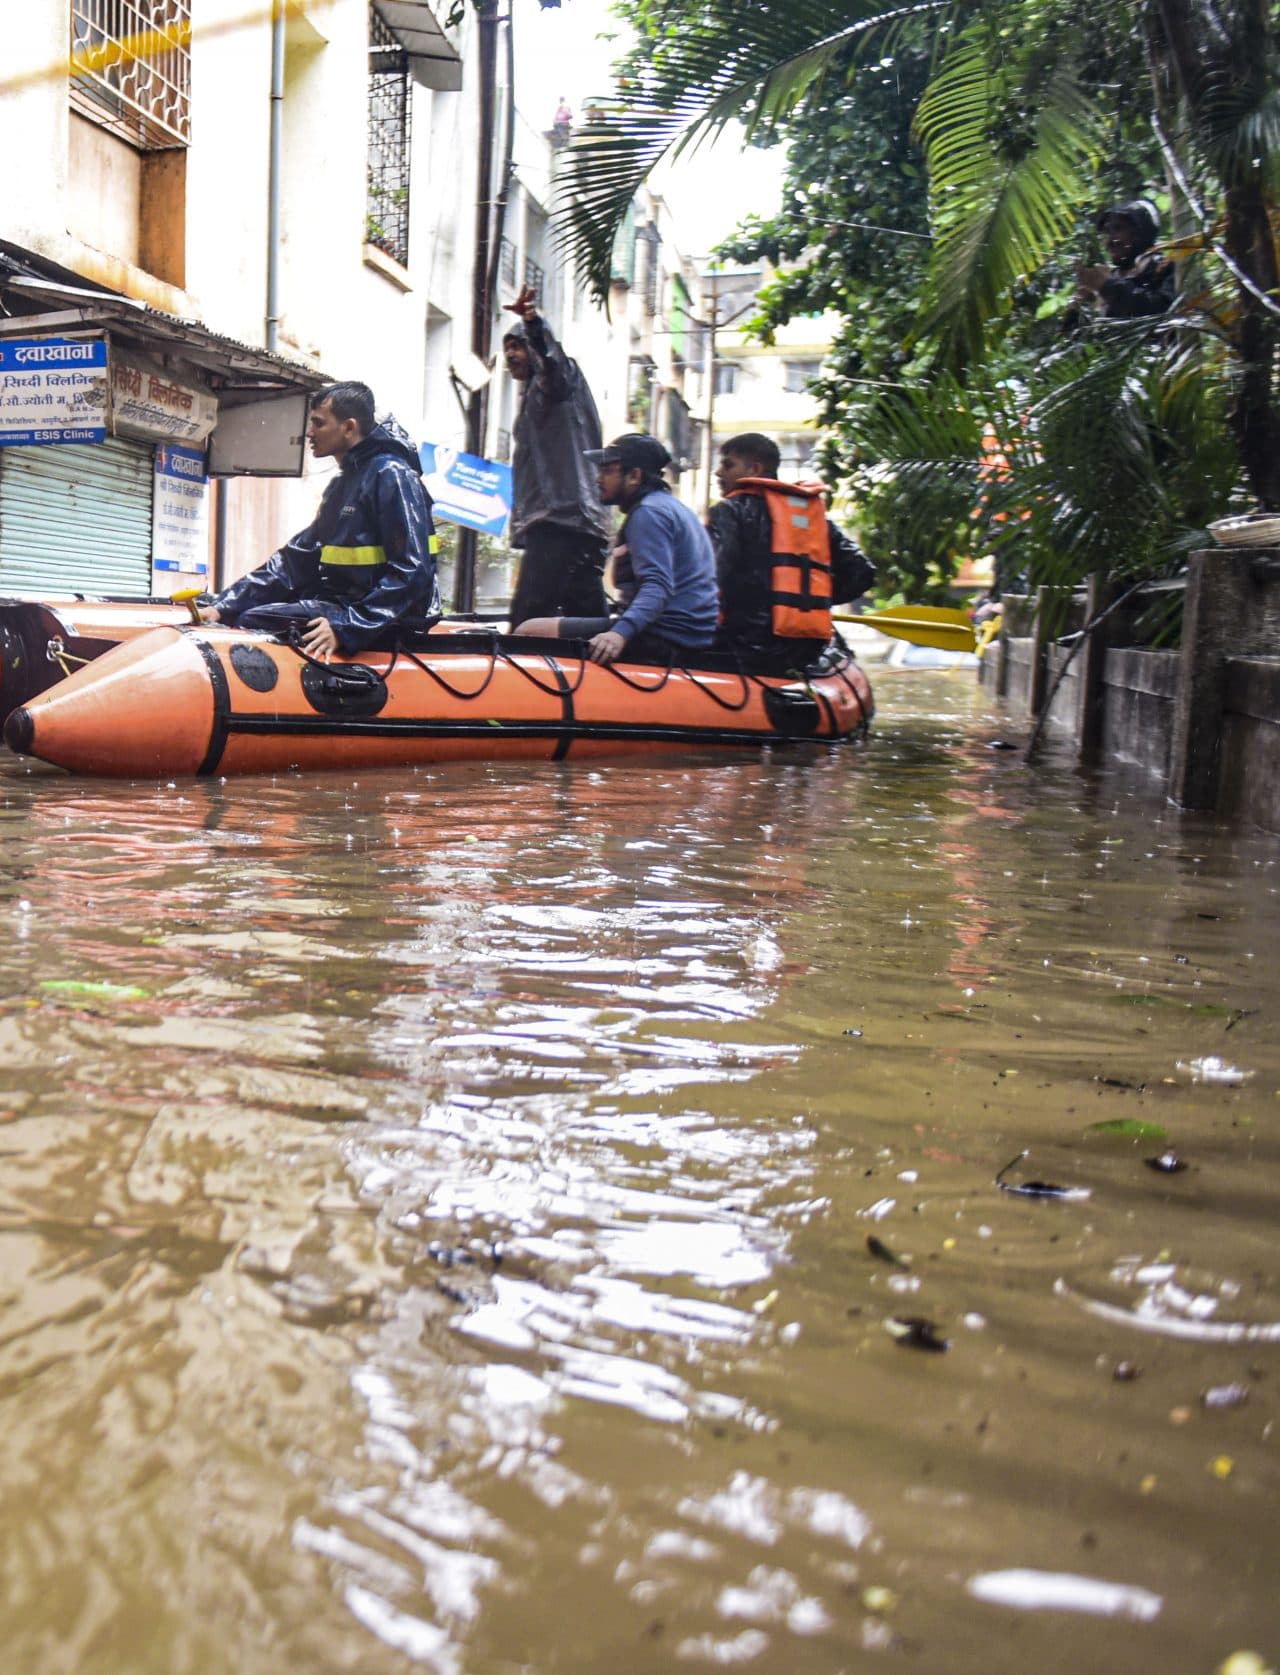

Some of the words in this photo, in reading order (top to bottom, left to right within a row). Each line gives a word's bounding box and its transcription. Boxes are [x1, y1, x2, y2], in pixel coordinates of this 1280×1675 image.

[14, 344, 94, 363] दवाखाना
[34, 430, 60, 440] ESIS
[63, 429, 95, 440] Clinic
